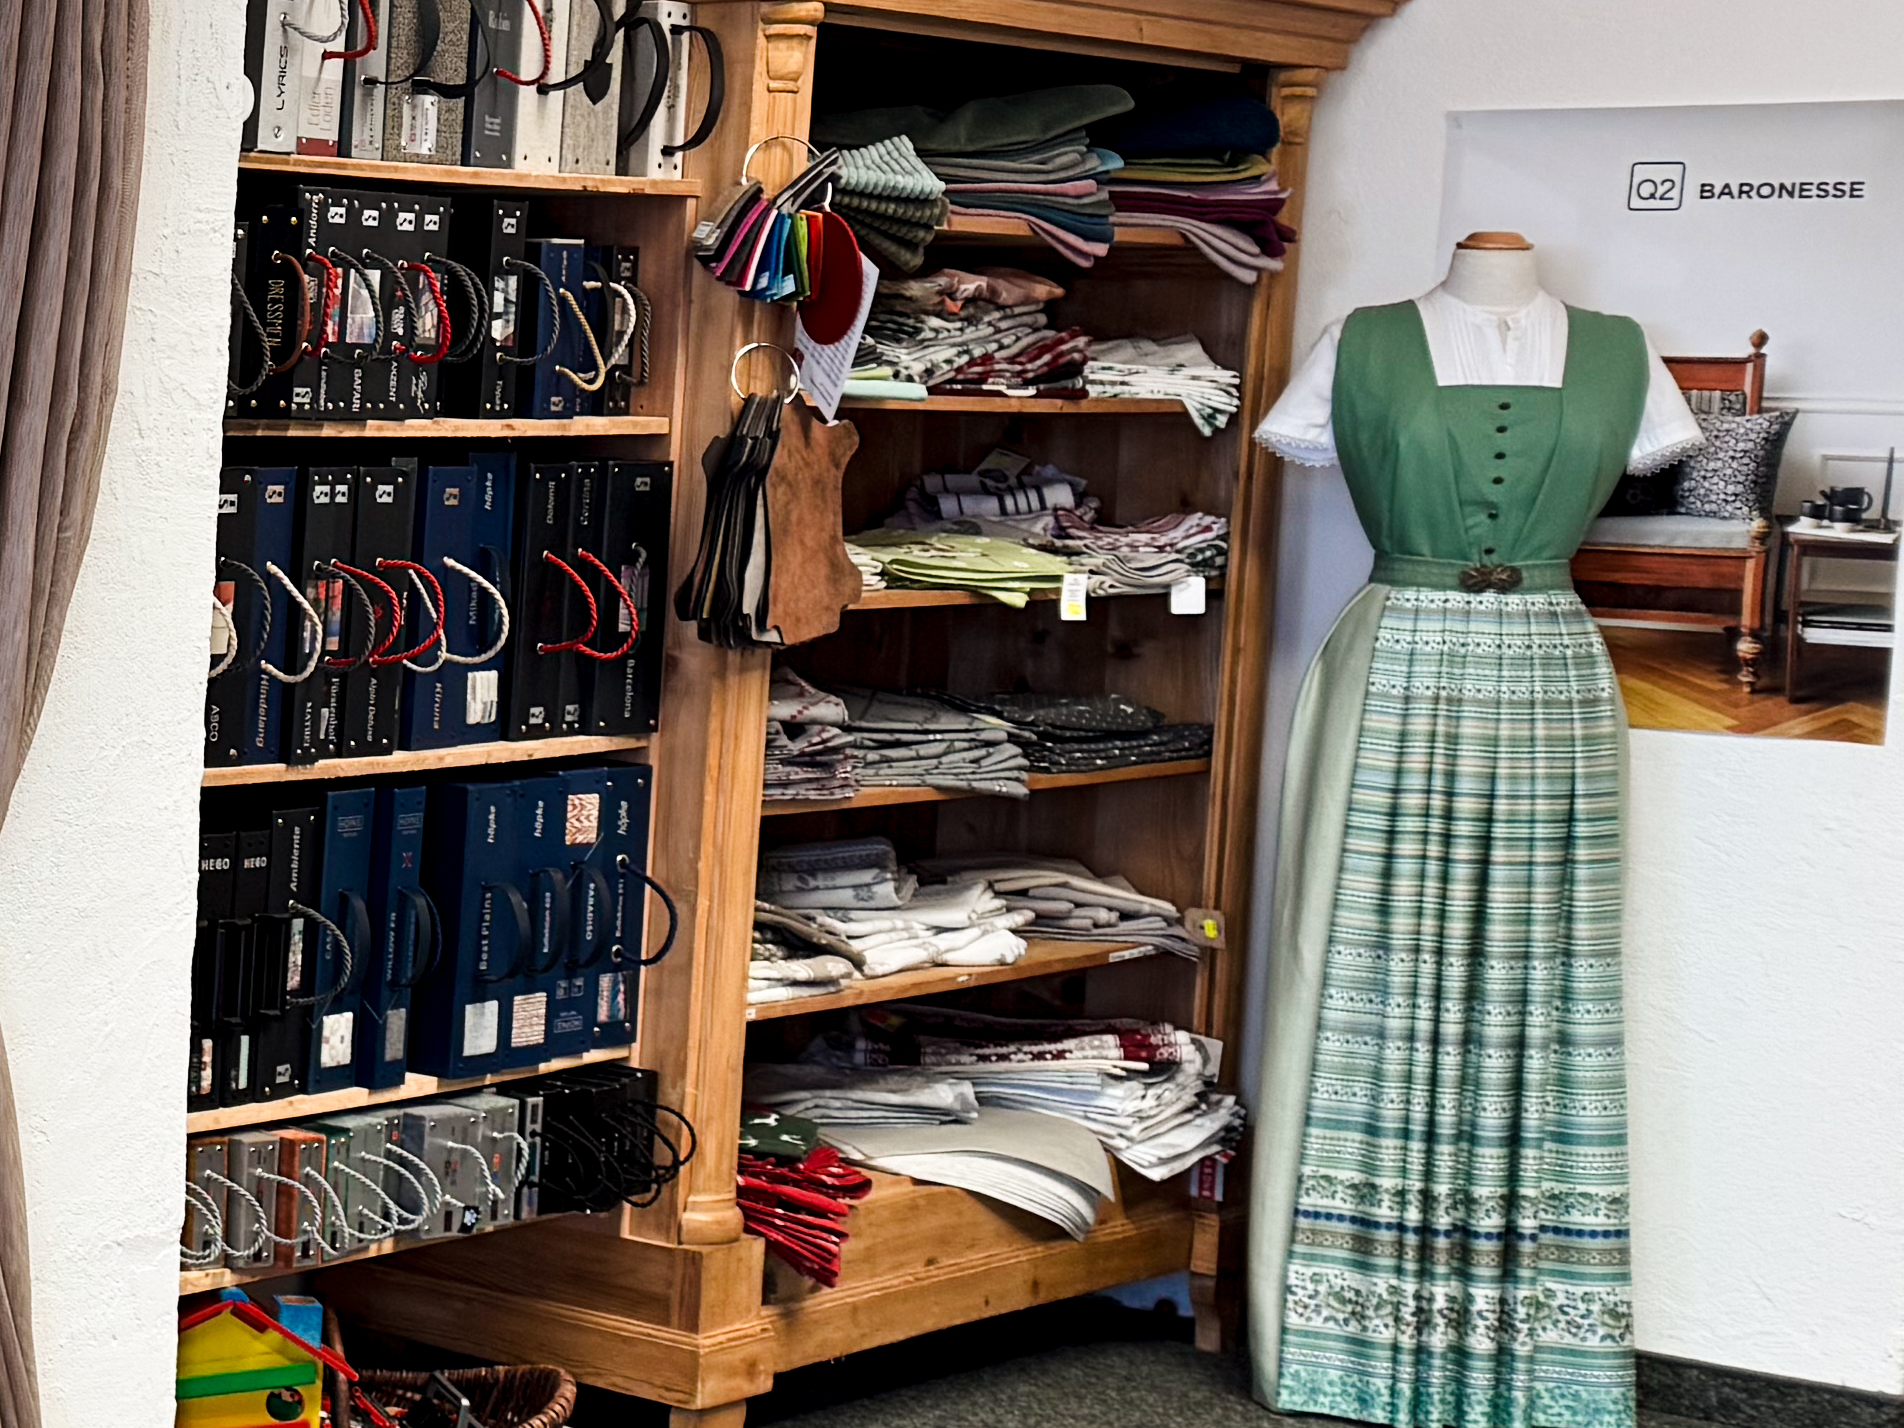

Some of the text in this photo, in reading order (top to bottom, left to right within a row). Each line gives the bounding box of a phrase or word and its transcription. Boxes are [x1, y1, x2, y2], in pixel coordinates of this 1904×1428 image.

[276, 45, 289, 110] LYRICS
[1636, 178, 1866, 200] Q2 BARONESSE
[307, 194, 322, 247] Andorra
[624, 659, 636, 718] Barcelona
